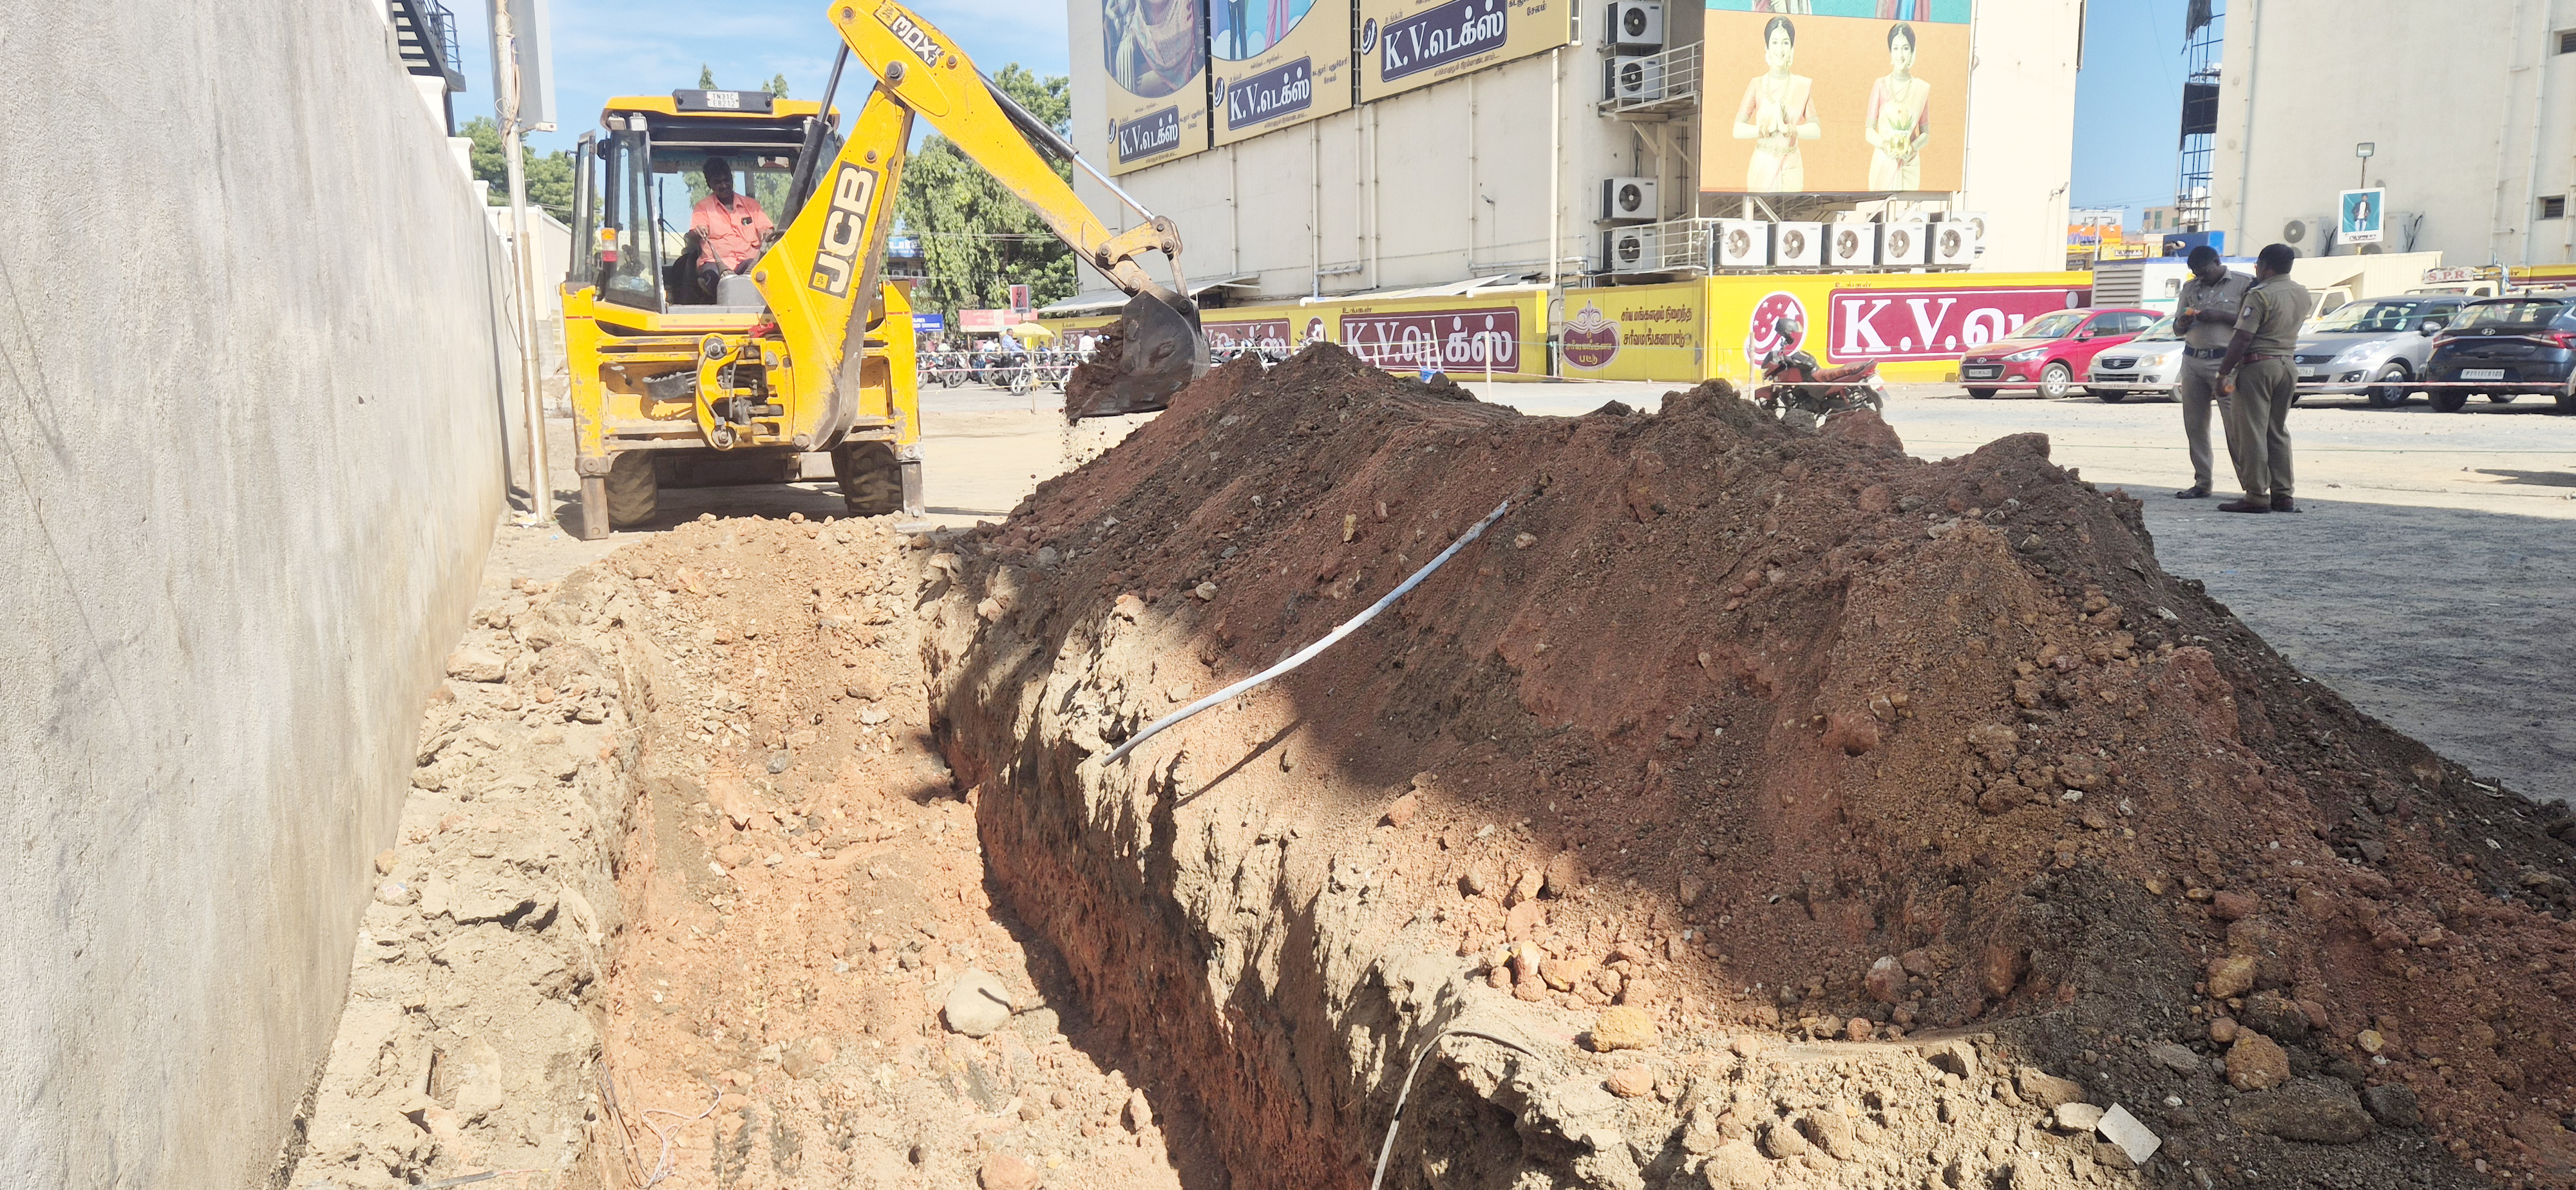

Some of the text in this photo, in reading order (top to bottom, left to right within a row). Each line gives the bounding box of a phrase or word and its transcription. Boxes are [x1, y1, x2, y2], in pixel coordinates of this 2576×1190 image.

[892, 16, 938, 62] 3DX
[1384, 0, 1504, 71] K.V.டெக்ஸ்
[1229, 66, 1311, 122] K.V.டெக்ஸ்
[1119, 113, 1179, 156] K.V.டெக்ஸ்
[818, 167, 873, 293] JCB
[2429, 270, 2466, 281] S.P.R
